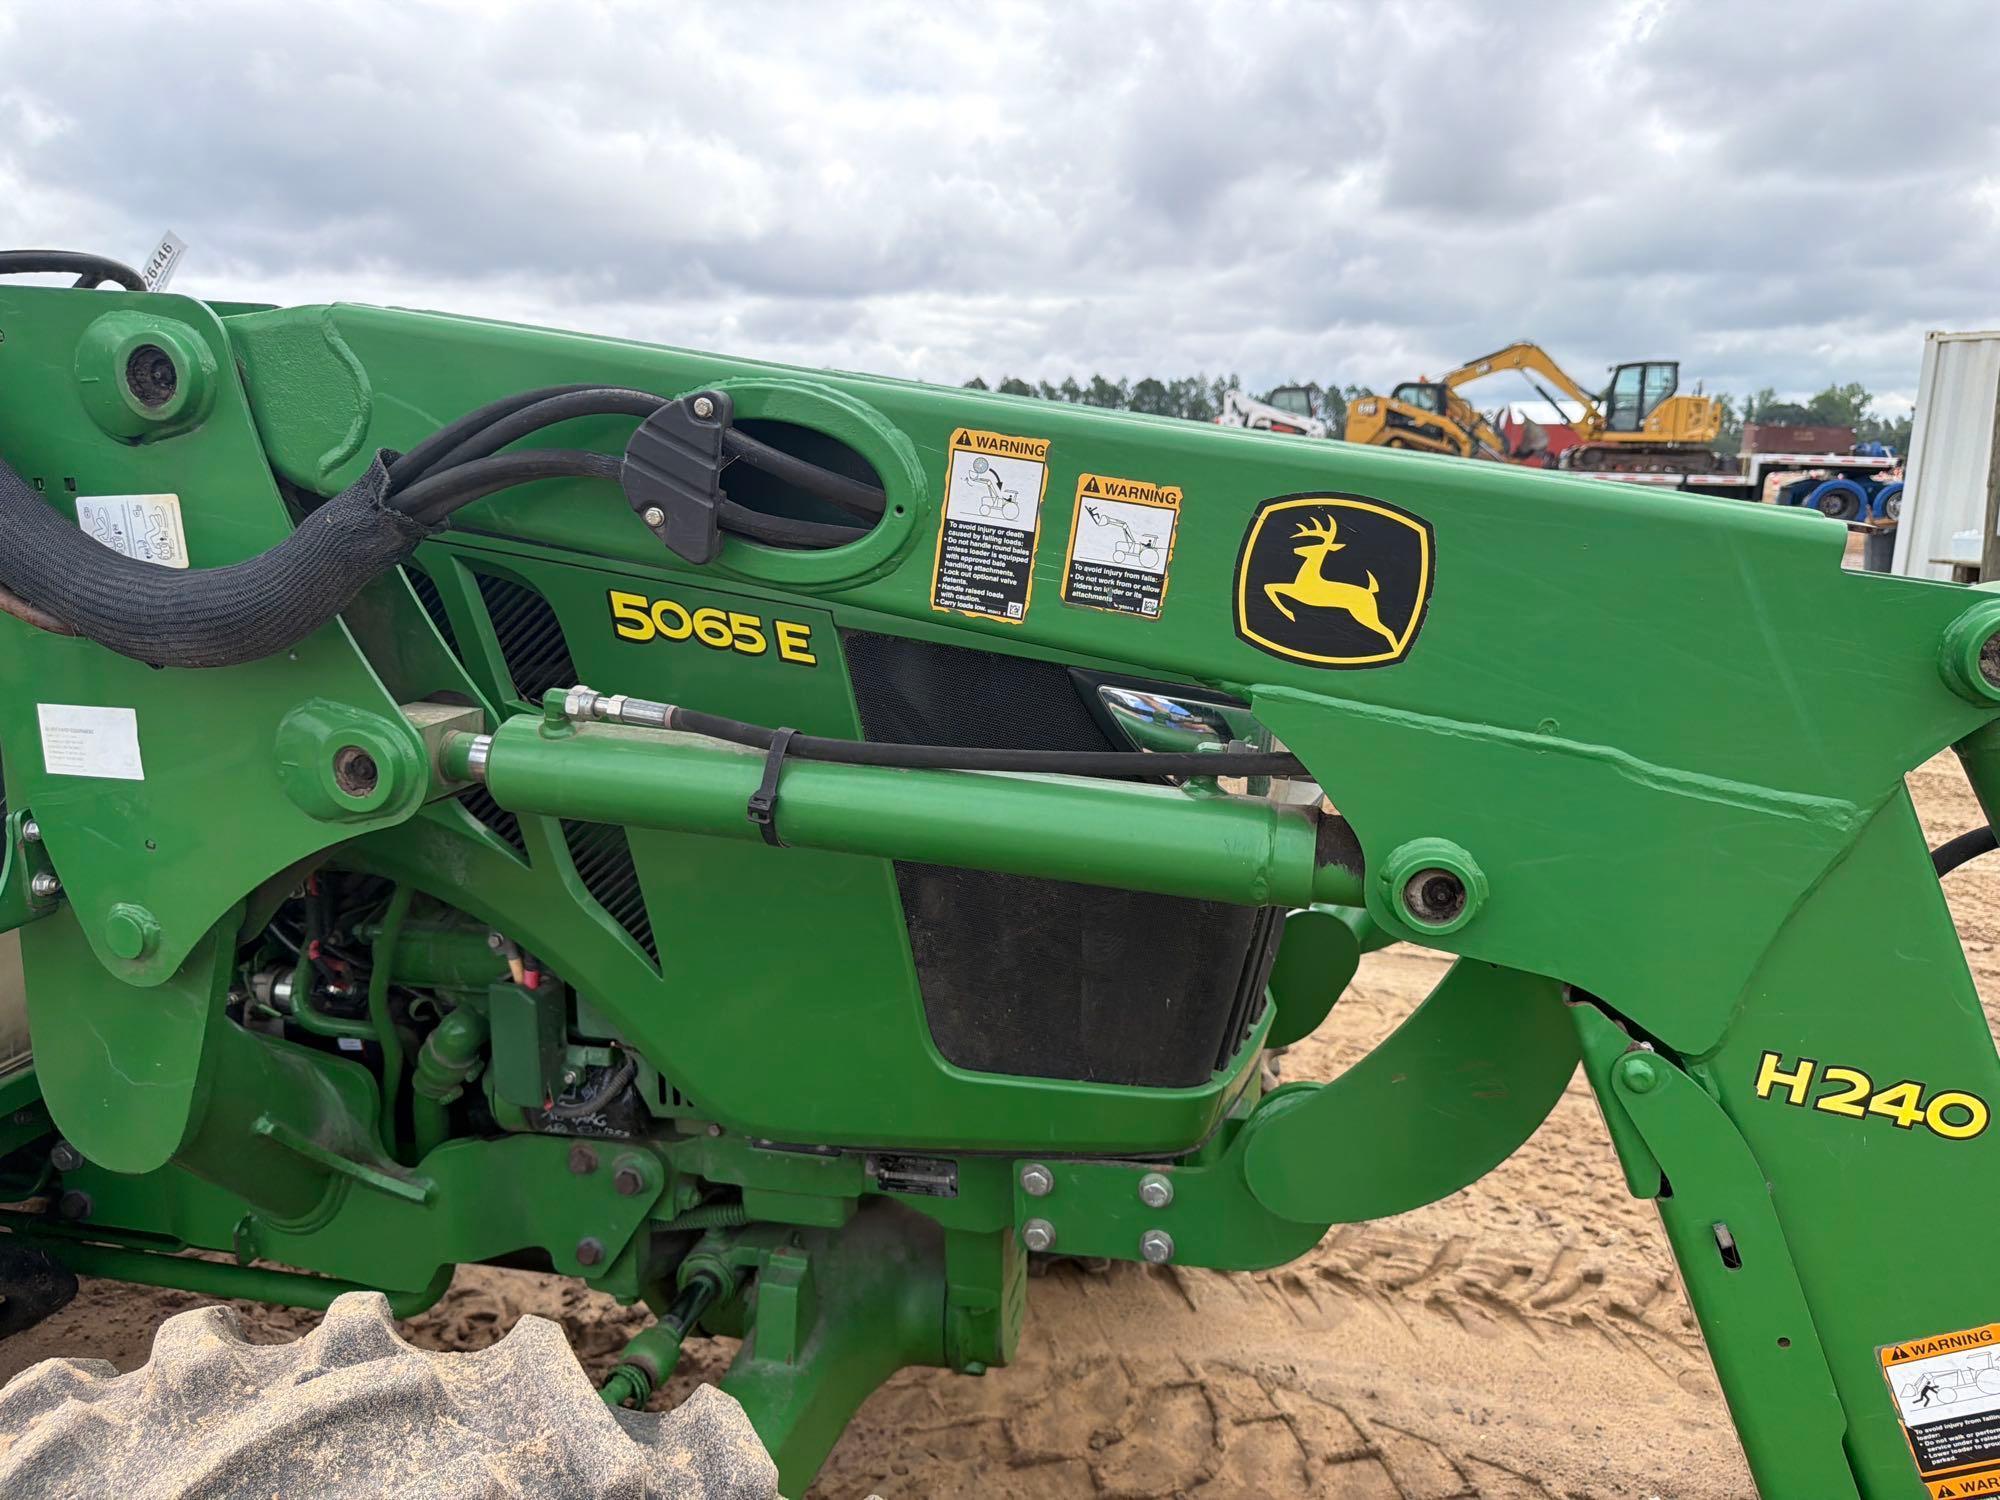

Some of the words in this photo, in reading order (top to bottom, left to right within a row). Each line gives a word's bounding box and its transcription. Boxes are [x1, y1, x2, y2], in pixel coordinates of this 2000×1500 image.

[143, 242, 173, 288] 26446
[977, 436, 1045, 457] WARNING
[1105, 482, 1177, 504] WARNING
[948, 530, 971, 538] caused
[982, 535, 1002, 544] falling
[1004, 538, 1023, 546] loads:
[978, 525, 996, 534] injury
[1006, 530, 1024, 538] death
[970, 540, 991, 549] handle
[992, 543, 1011, 552] round
[1012, 546, 1029, 555] bales
[961, 555, 990, 565] approved
[970, 548, 990, 557] loader
[999, 553, 1028, 564] equipped
[944, 568, 959, 576] Lock
[973, 572, 999, 582] optional
[1000, 577, 1017, 585] valve
[945, 561, 972, 571] handling
[974, 564, 1014, 577] attachments.
[1104, 568, 1123, 578] injury
[943, 576, 968, 585] detents.
[1142, 584, 1160, 593] allow
[942, 583, 964, 592] Handle
[965, 587, 985, 595] raised
[986, 591, 1004, 599] loads
[956, 594, 981, 602] caution.
[1104, 586, 1124, 596] loder
[1134, 590, 1142, 599] its
[940, 599, 956, 607] Carry
[957, 601, 974, 609] loads
[608, 589, 768, 656] 5065
[774, 619, 818, 667] E
[1754, 1050, 1991, 1141] H240
[1910, 1330, 1992, 1356] WARNING
[1932, 1456, 1957, 1465] parked.
[1960, 1477, 2000, 1493] WAR
